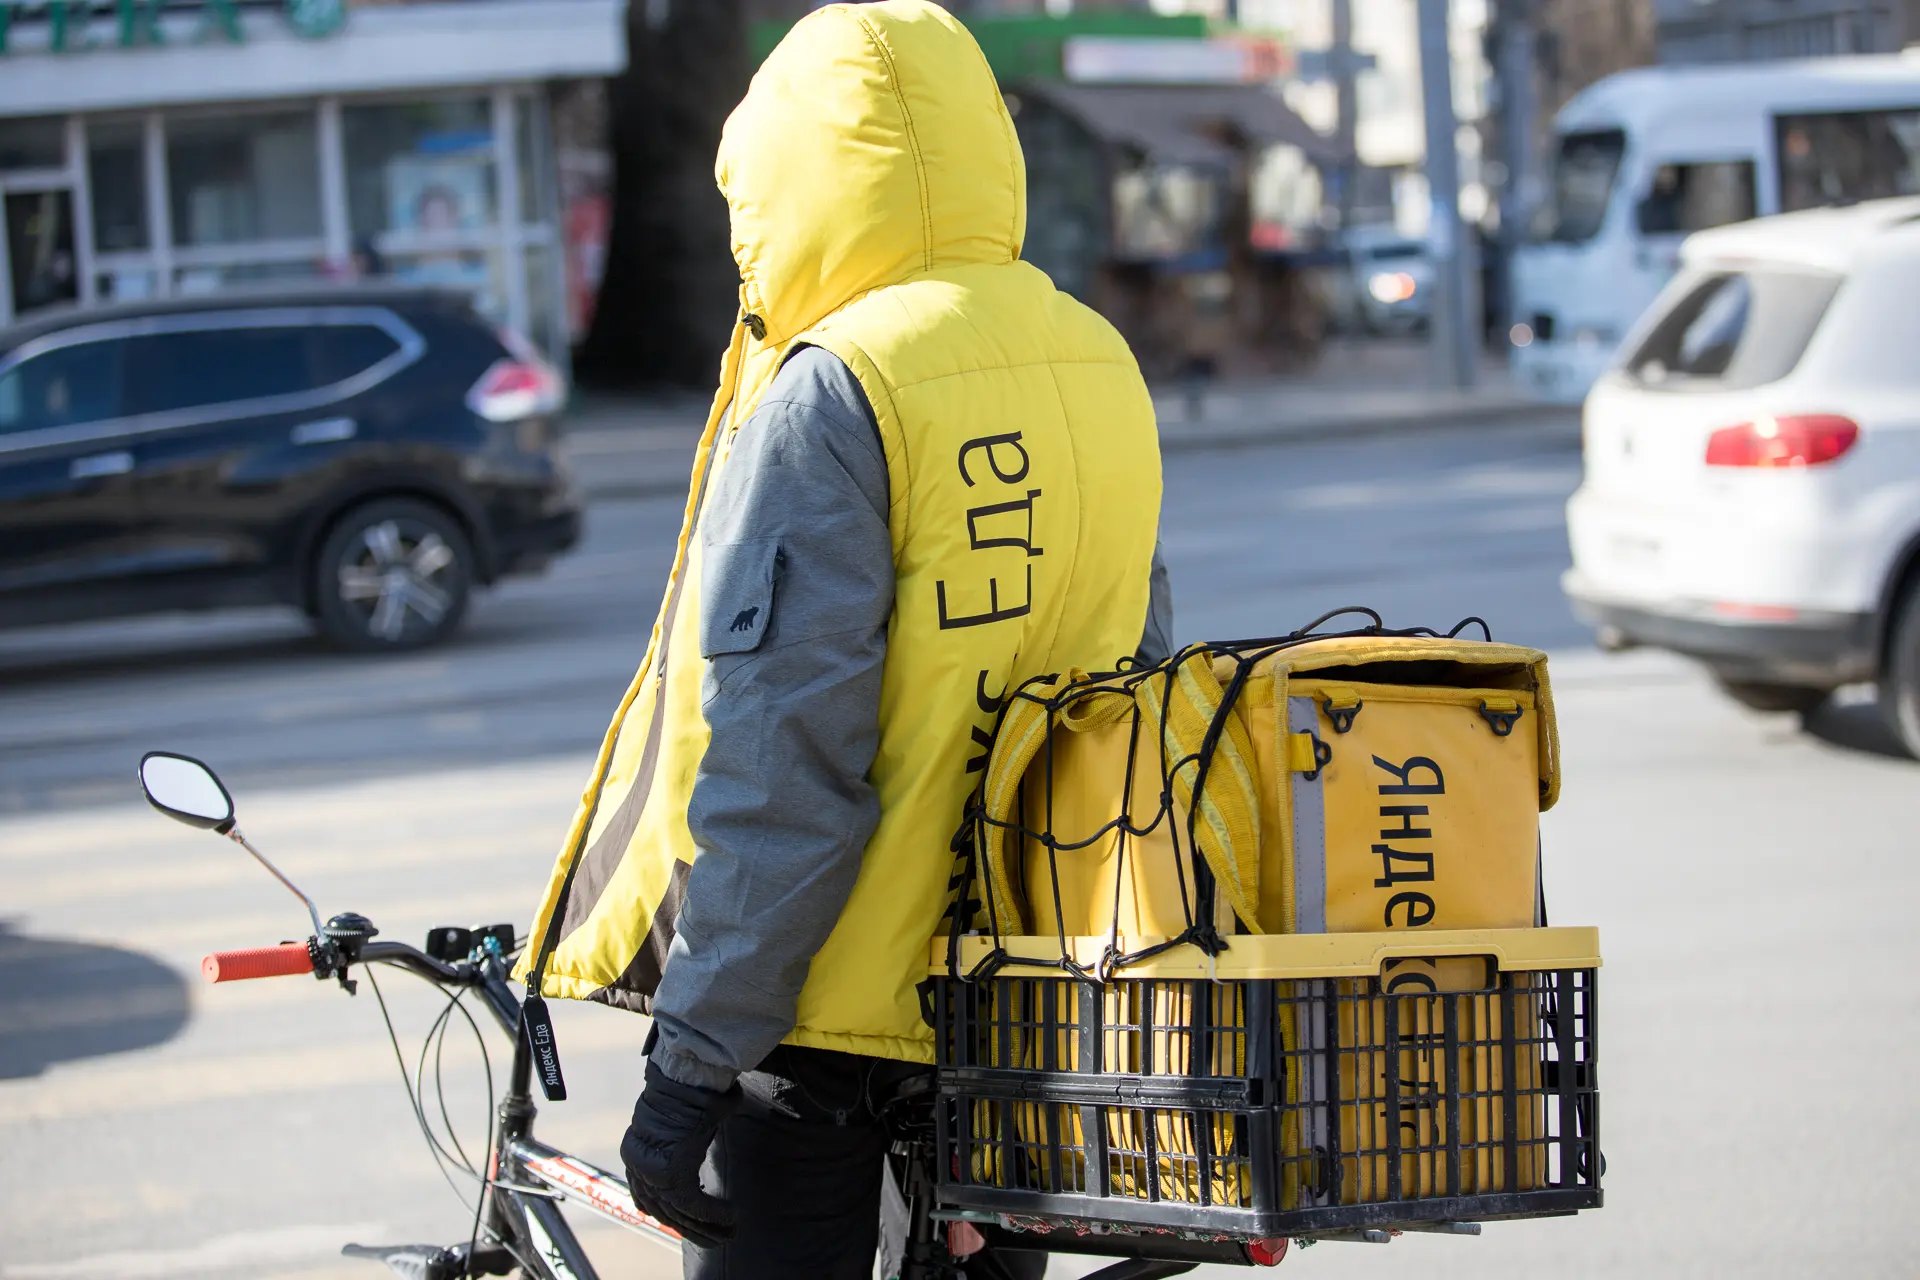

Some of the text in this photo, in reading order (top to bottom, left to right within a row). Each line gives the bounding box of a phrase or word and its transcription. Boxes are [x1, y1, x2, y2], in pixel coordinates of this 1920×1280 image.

[936, 430, 1043, 630] Еда
[1371, 754, 1446, 1005] Яндес
[535, 1023, 560, 1085] Яндекс Еда
